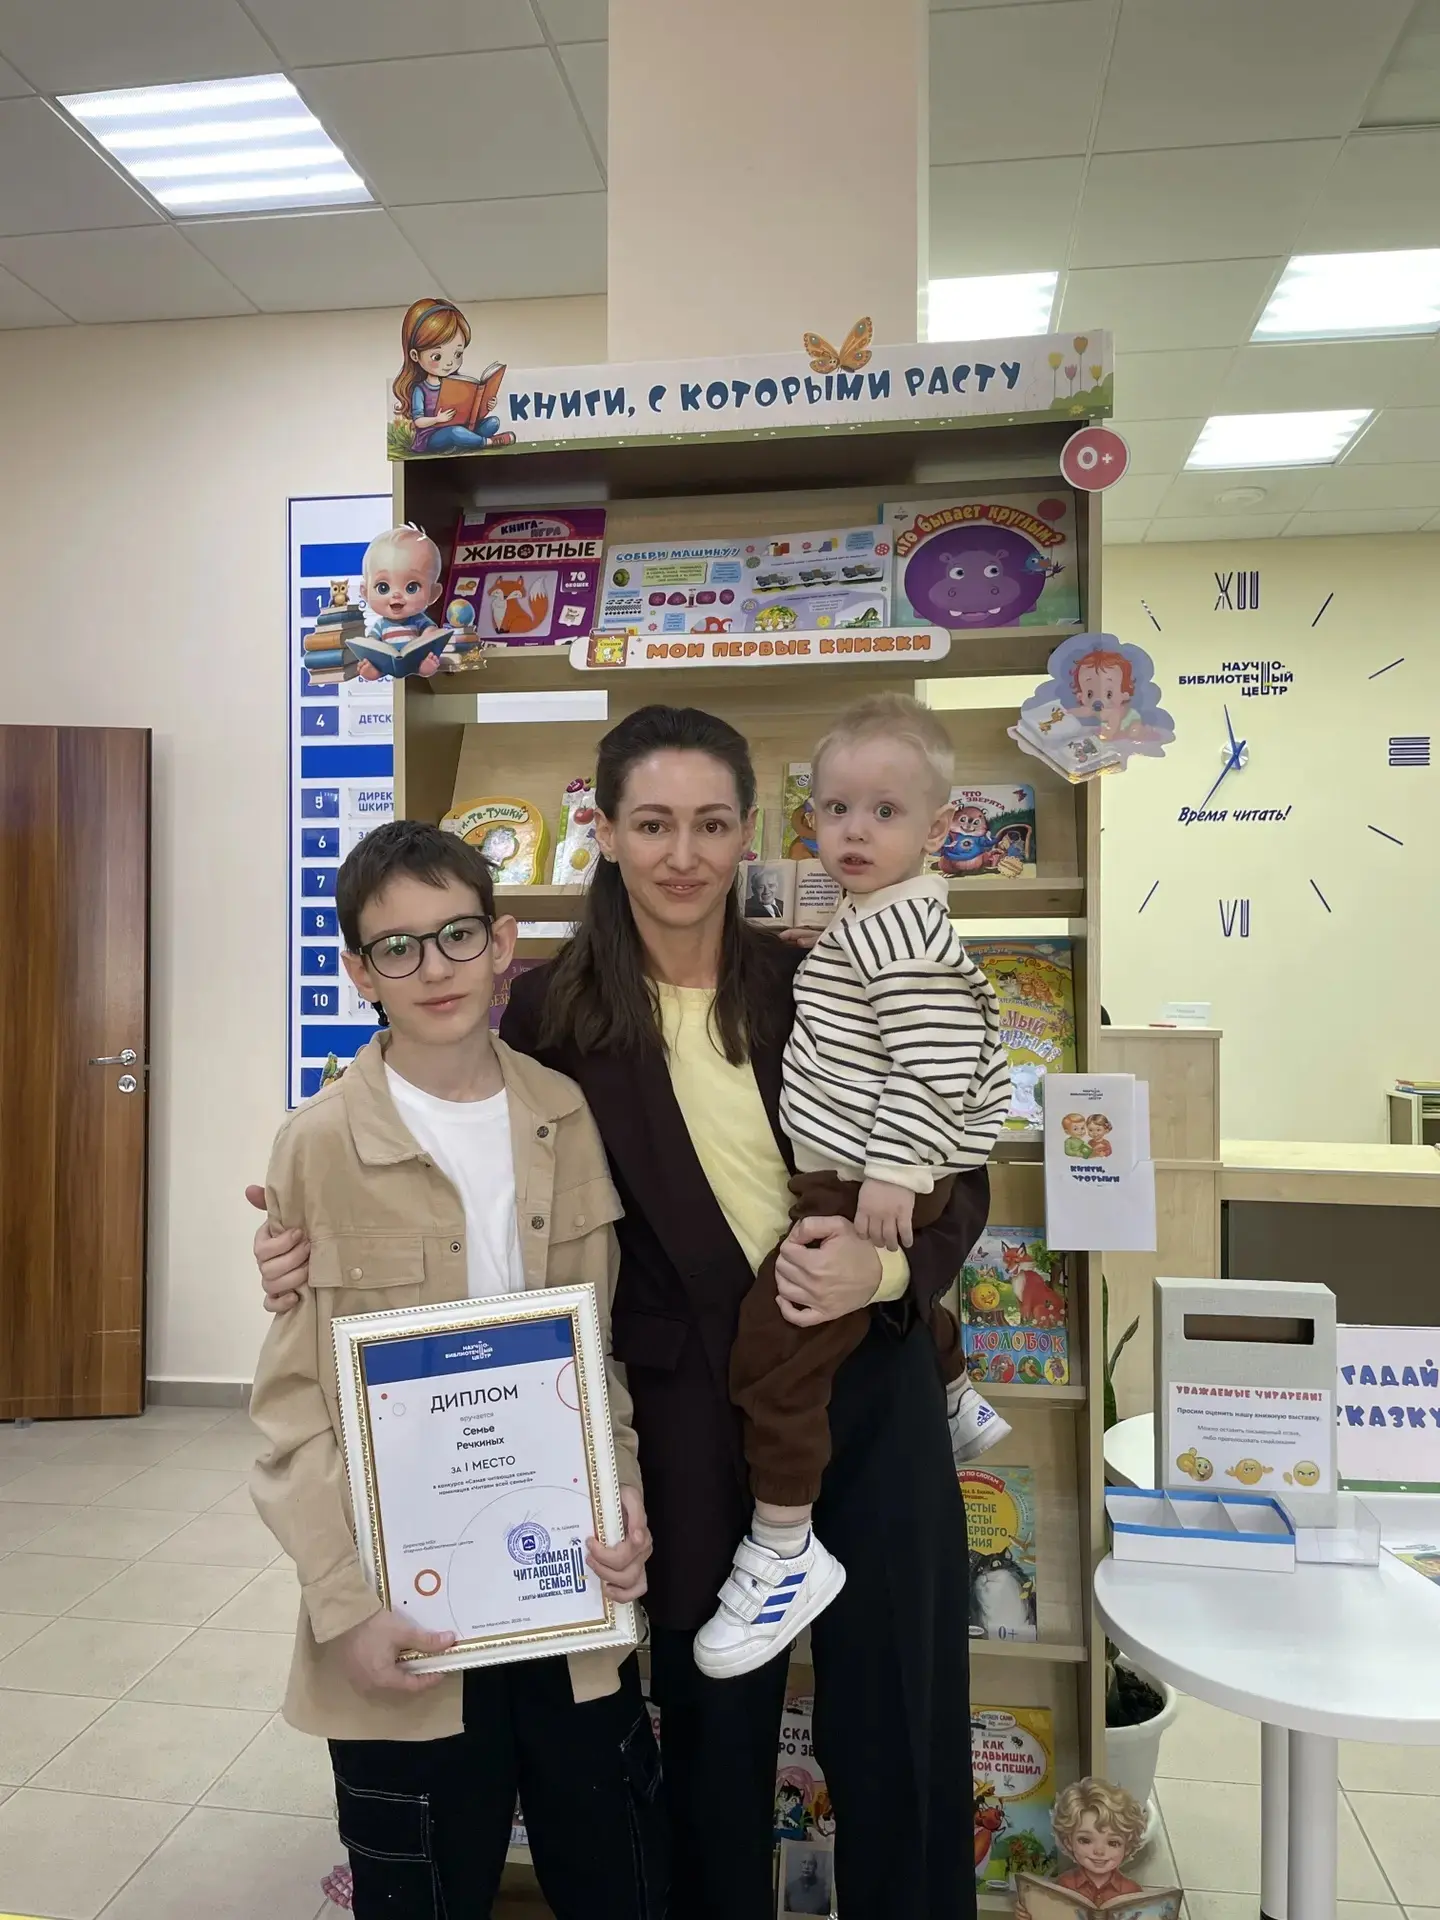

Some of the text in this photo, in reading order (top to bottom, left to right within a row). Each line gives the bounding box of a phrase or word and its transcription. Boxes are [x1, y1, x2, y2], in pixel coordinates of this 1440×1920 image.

[509, 361, 1021, 421] КНИГИ, С КОТОРЫМИ РАСТУ
[1077, 446, 1113, 470] 0+
[501, 520, 543, 535] КНИГА-
[530, 527, 562, 538] ИГРА
[462, 542, 596, 561] ЖИВОТНЫЕ
[616, 548, 741, 562] СОБЕРИ МАШИНУ!
[570, 571, 587, 581] 70
[647, 635, 931, 659] МОИ ПЕРВЫЕ КНИЖКИ
[316, 714, 325, 727] 4
[315, 796, 323, 808] 5
[1178, 805, 1292, 826] Время читать!
[318, 836, 326, 849] 6
[316, 876, 325, 888] 7
[316, 915, 324, 927] 8
[1219, 899, 1250, 937] VI
[317, 954, 326, 967] 9
[312, 994, 329, 1006] 10
[972, 1331, 1065, 1353] КОЛОБОК
[1176, 1385, 1250, 1398] УВАЖАЕМЫЕ
[430, 1384, 518, 1413] ДИПЛОМ
[460, 1412, 494, 1422] вручается
[1177, 1407, 1203, 1415] Просим
[1205, 1409, 1233, 1417] оценить
[463, 1425, 495, 1436] Семье
[456, 1437, 504, 1450] Речкиных
[451, 1466, 461, 1474] ЗА
[472, 1455, 515, 1471] МЕСТО
[438, 1481, 464, 1490] конкурсе
[535, 1549, 569, 1565] САМАЯ
[513, 1562, 571, 1581] ЧИТАЮЩАЯ
[539, 1575, 572, 1591] СЕМЬЯ
[998, 1626, 1018, 1640] 0+
[982, 1740, 1004, 1750] КАК
[995, 1764, 1041, 1775] СПЕШИЛ
